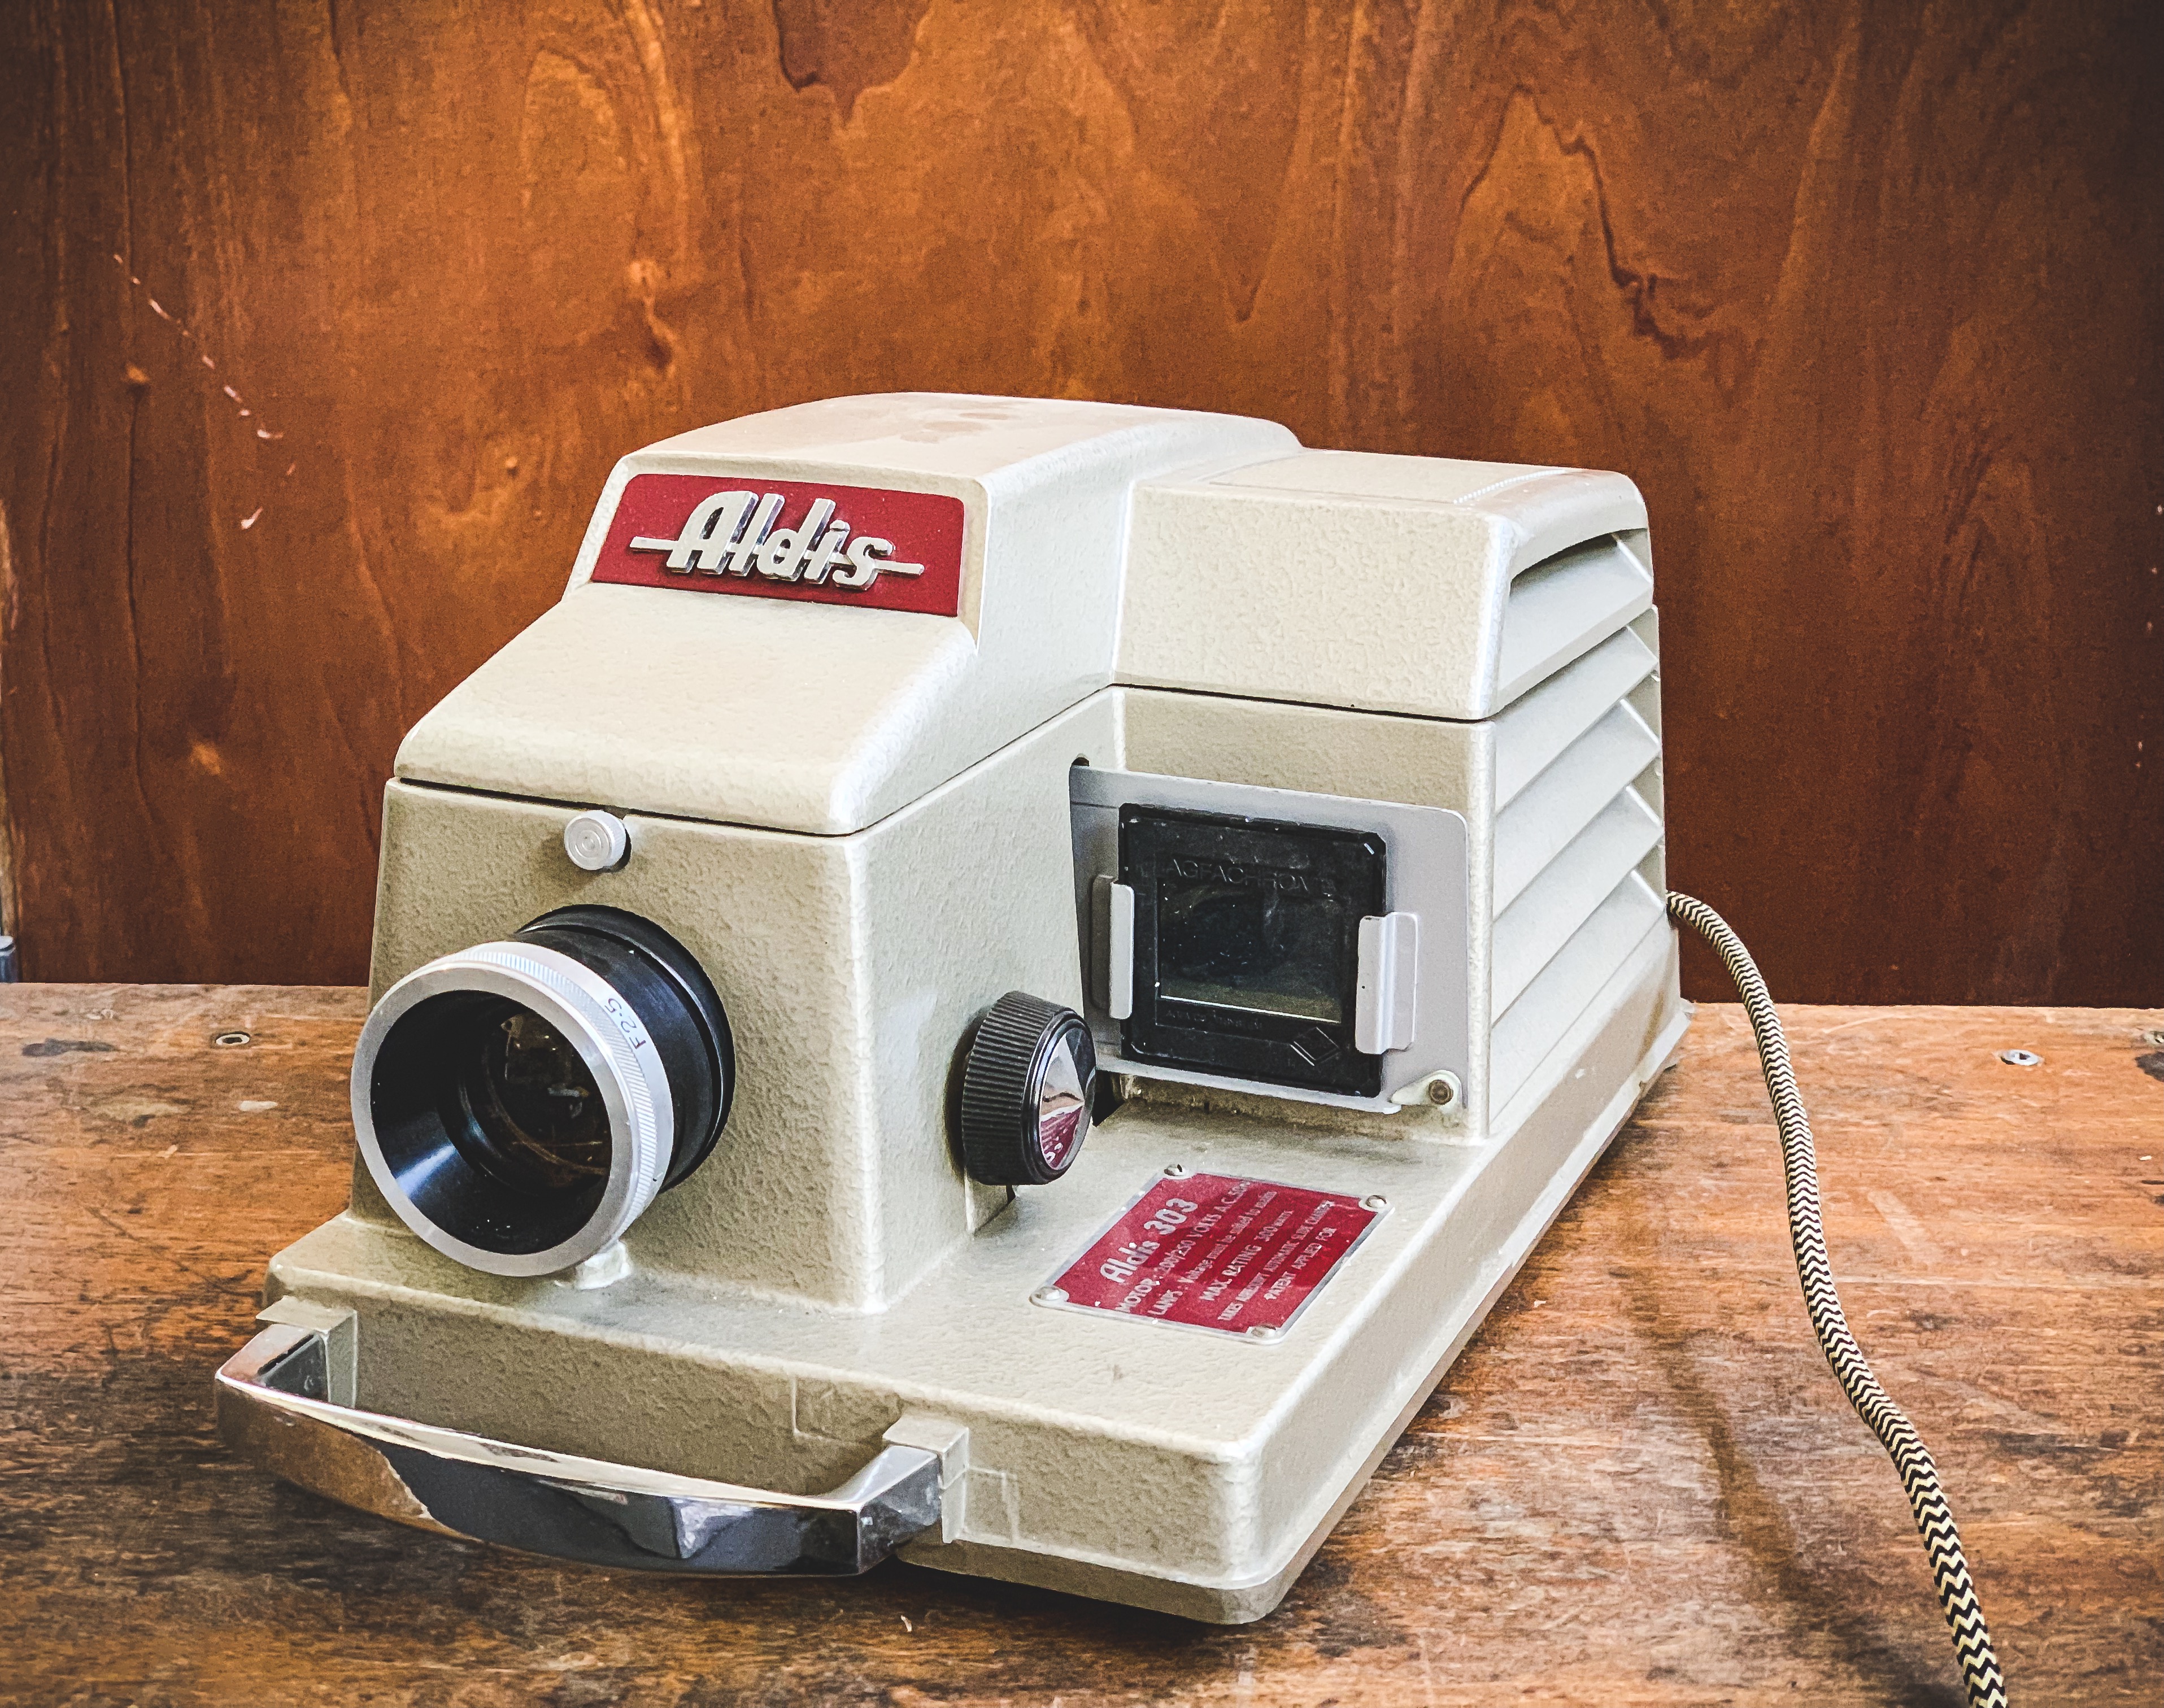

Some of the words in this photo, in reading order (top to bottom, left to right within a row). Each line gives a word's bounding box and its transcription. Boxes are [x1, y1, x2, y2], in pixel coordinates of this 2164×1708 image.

[667, 491, 895, 590] Aldis
[1100, 1241, 1160, 1284] Aldis
[1144, 1199, 1198, 1234] 303
[1187, 1214, 1222, 1237] VOLTS
[1222, 1245, 1261, 1276] RATING
[1254, 1226, 1278, 1241] 300
[1264, 1271, 1295, 1300] PATENT
[1291, 1243, 1322, 1269] APPLIED
[1316, 1227, 1336, 1240] FOR
